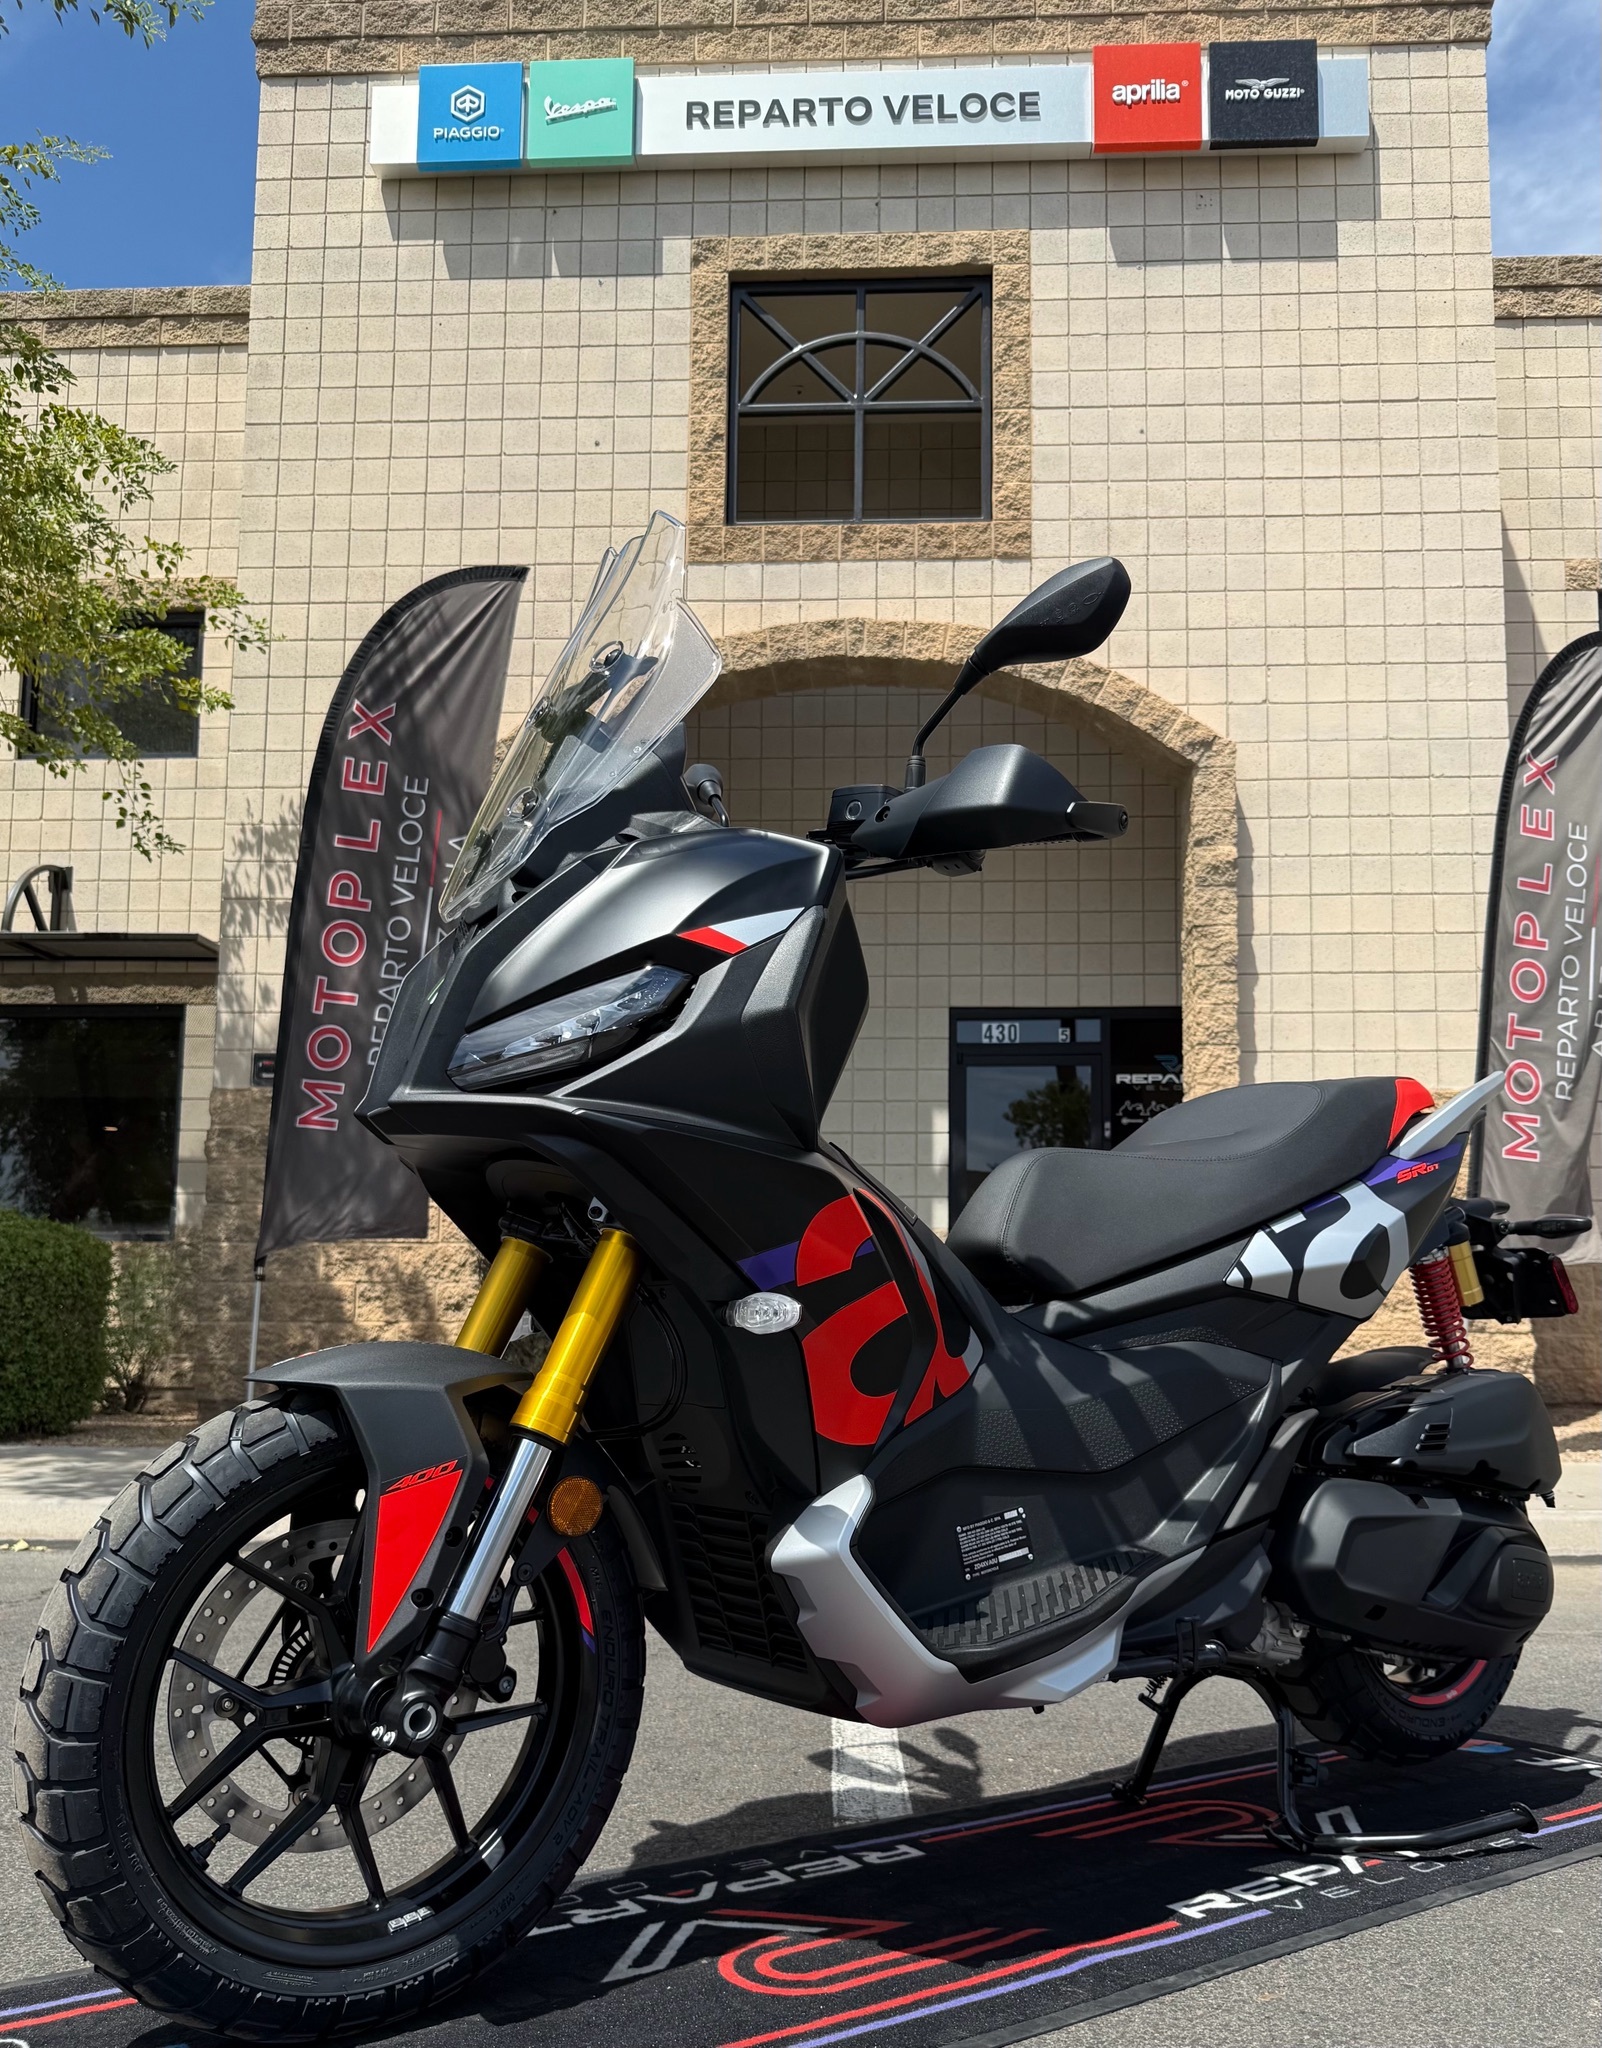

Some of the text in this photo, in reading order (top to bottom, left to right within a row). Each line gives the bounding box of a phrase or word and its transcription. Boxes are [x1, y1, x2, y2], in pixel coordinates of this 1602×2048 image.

[1112, 79, 1180, 105] aprilia
[1225, 88, 1301, 100] MOTO GUZZI
[544, 95, 617, 121] Vespa
[686, 91, 1041, 129] REPARTO VELOCE
[433, 126, 501, 141] PIAGGIO
[391, 775, 429, 906] VELOCE
[295, 699, 398, 1132] MOTOPLEX
[1502, 748, 1558, 1162] MOTOPLEX
[1555, 821, 1588, 1102] REPARTO VELOCE
[983, 1023, 1018, 1043] 430
[1060, 1029, 1069, 1042] 5
[1115, 1073, 1182, 1085] REPA
[386, 1460, 458, 1492] 400
